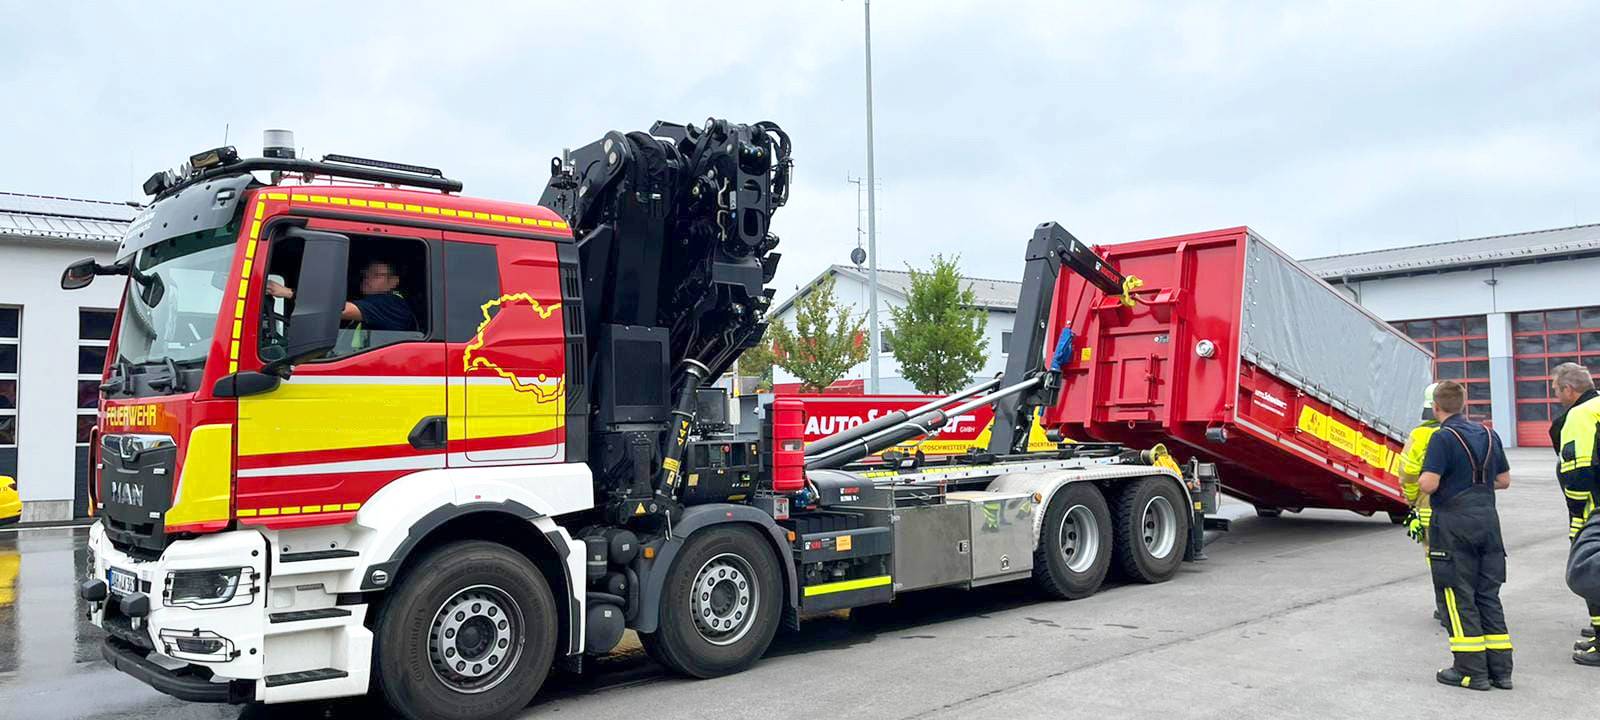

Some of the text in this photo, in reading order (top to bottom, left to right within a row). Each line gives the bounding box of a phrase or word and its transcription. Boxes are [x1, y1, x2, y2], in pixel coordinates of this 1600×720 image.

[106, 404, 157, 426] FEUERWEHR
[804, 415, 864, 435] AUTO
[111, 481, 144, 507] MAN
